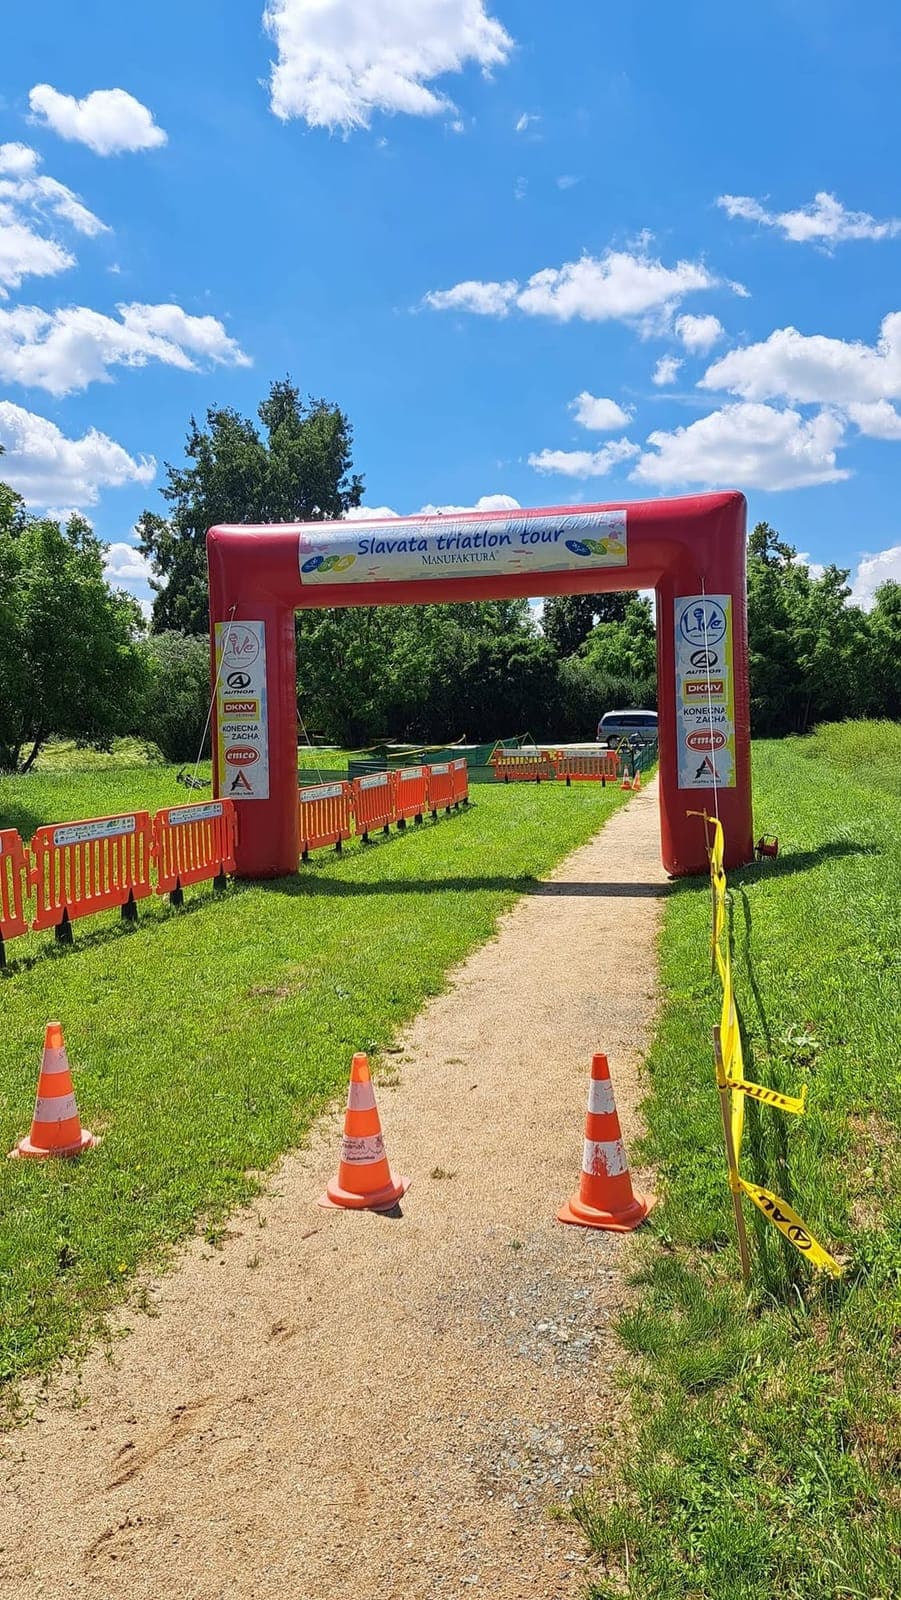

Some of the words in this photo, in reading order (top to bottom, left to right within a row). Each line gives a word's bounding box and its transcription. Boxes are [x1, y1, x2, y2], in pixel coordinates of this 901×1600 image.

[357, 537, 428, 556] Slavata
[436, 530, 511, 551] triatlon
[519, 527, 564, 544] tour
[422, 550, 497, 566] MANUFAKTURA
[688, 683, 721, 692] DKNV
[225, 703, 254, 711] DKNV
[690, 736, 722, 745] emco
[227, 752, 255, 760] emco
